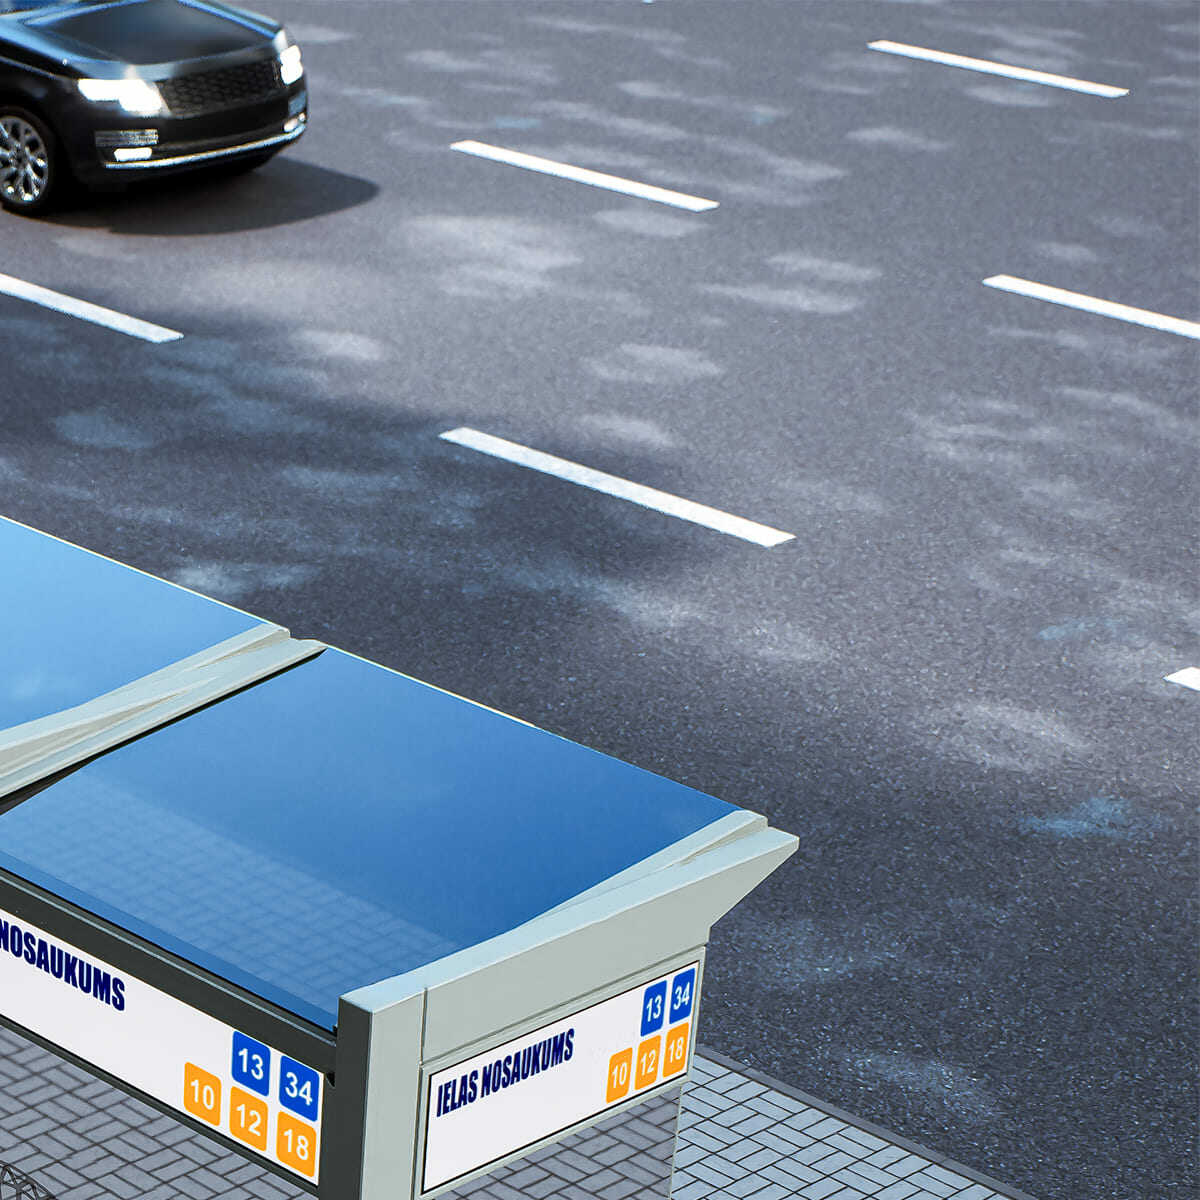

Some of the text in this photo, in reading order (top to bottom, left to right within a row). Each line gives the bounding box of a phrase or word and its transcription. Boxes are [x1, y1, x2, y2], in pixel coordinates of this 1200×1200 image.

[646, 982, 690, 1022] 13 34
[238, 1048, 313, 1106] 13 34
[436, 1028, 575, 1118] IELAS NOSAUKUMS
[611, 1036, 684, 1089] 10 12 18
[190, 1079, 309, 1161] 10 12 18
